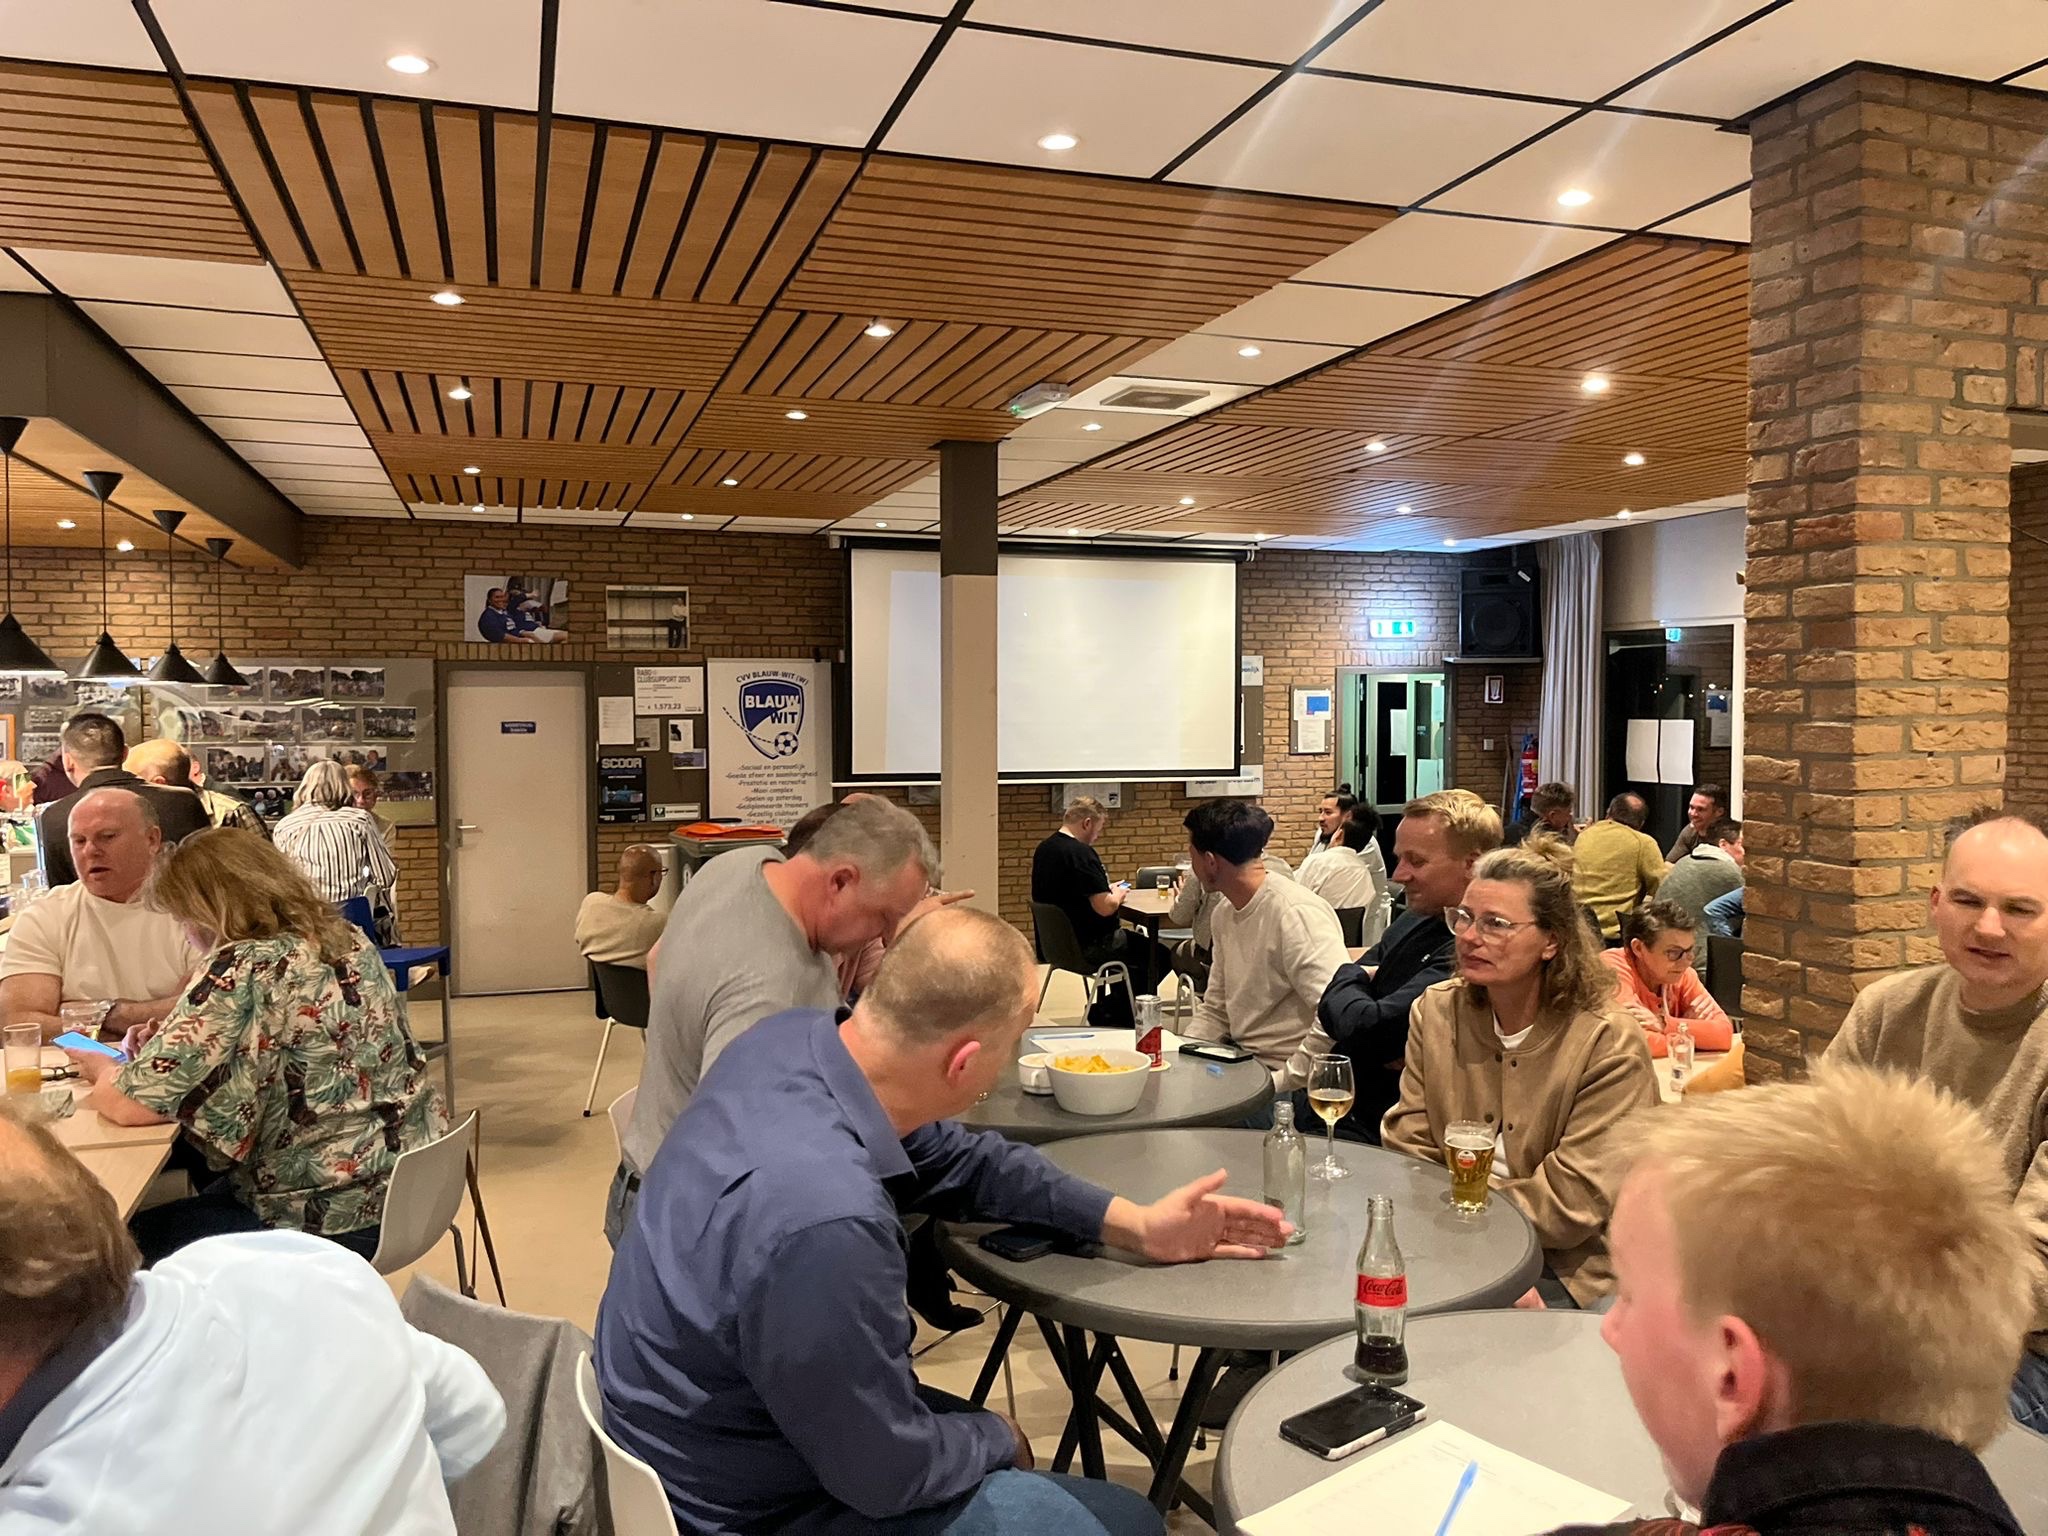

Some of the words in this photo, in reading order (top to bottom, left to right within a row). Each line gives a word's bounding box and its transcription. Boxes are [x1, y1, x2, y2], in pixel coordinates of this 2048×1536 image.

[736, 673, 751, 683] CVV
[752, 670, 795, 679] BLAUW-WIT
[745, 695, 800, 709] BLAUW
[770, 712, 798, 724] WIT
[1363, 1279, 1404, 1296] Coca-Cola
